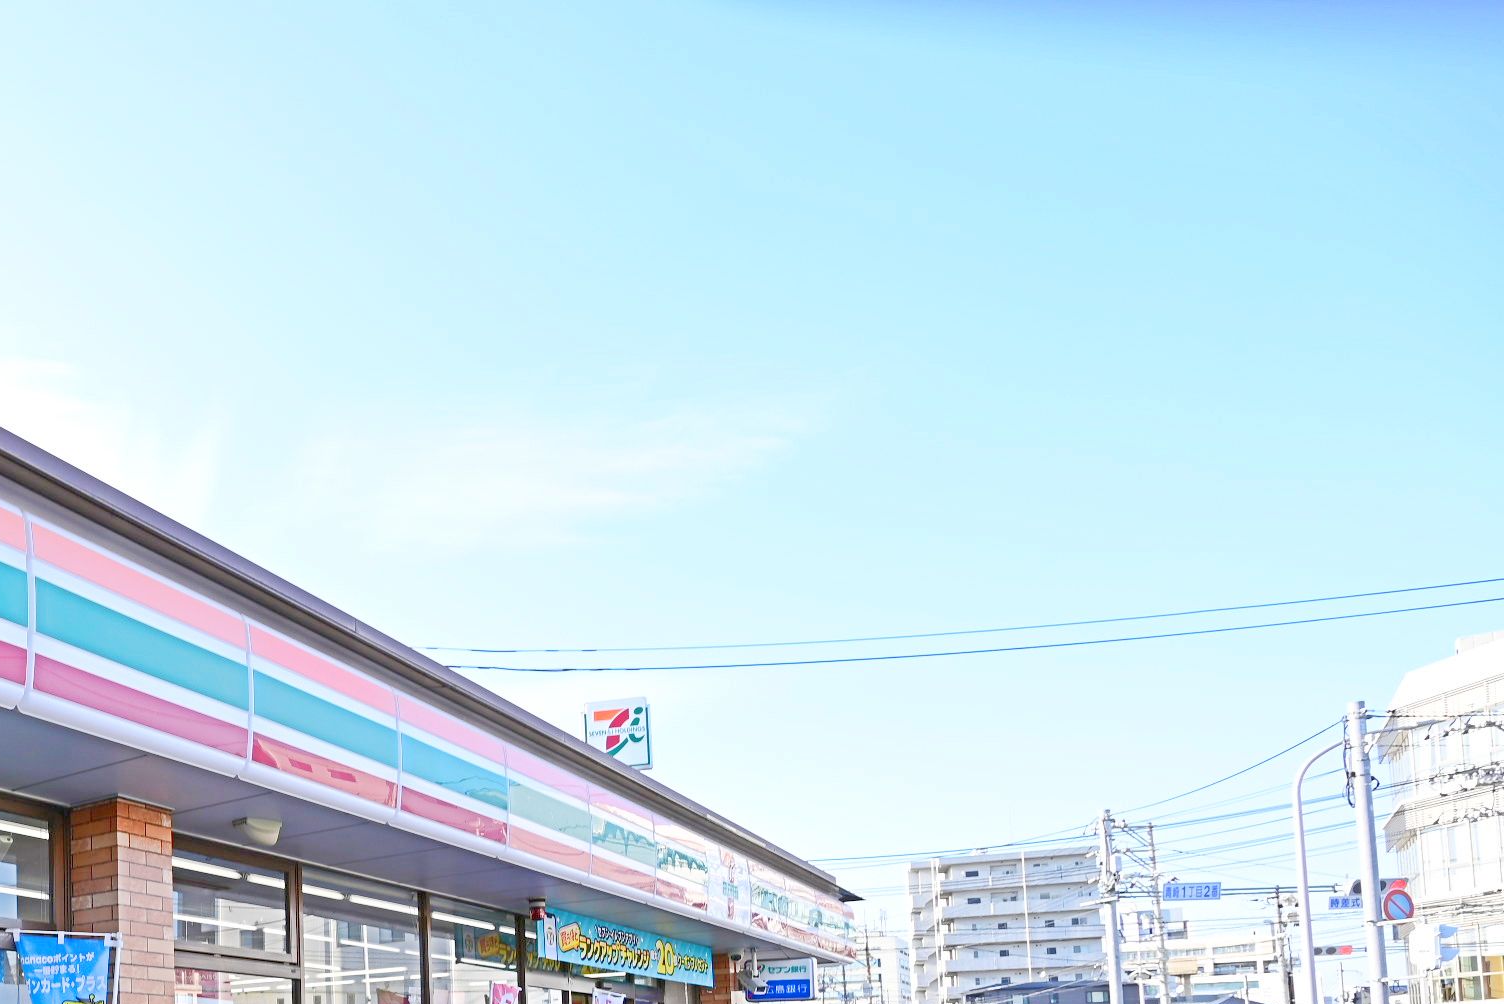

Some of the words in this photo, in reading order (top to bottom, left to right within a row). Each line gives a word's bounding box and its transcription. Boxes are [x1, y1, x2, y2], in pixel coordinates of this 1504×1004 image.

[1330, 898, 1361, 908] 時差式
[768, 965, 807, 974] セブン銀行
